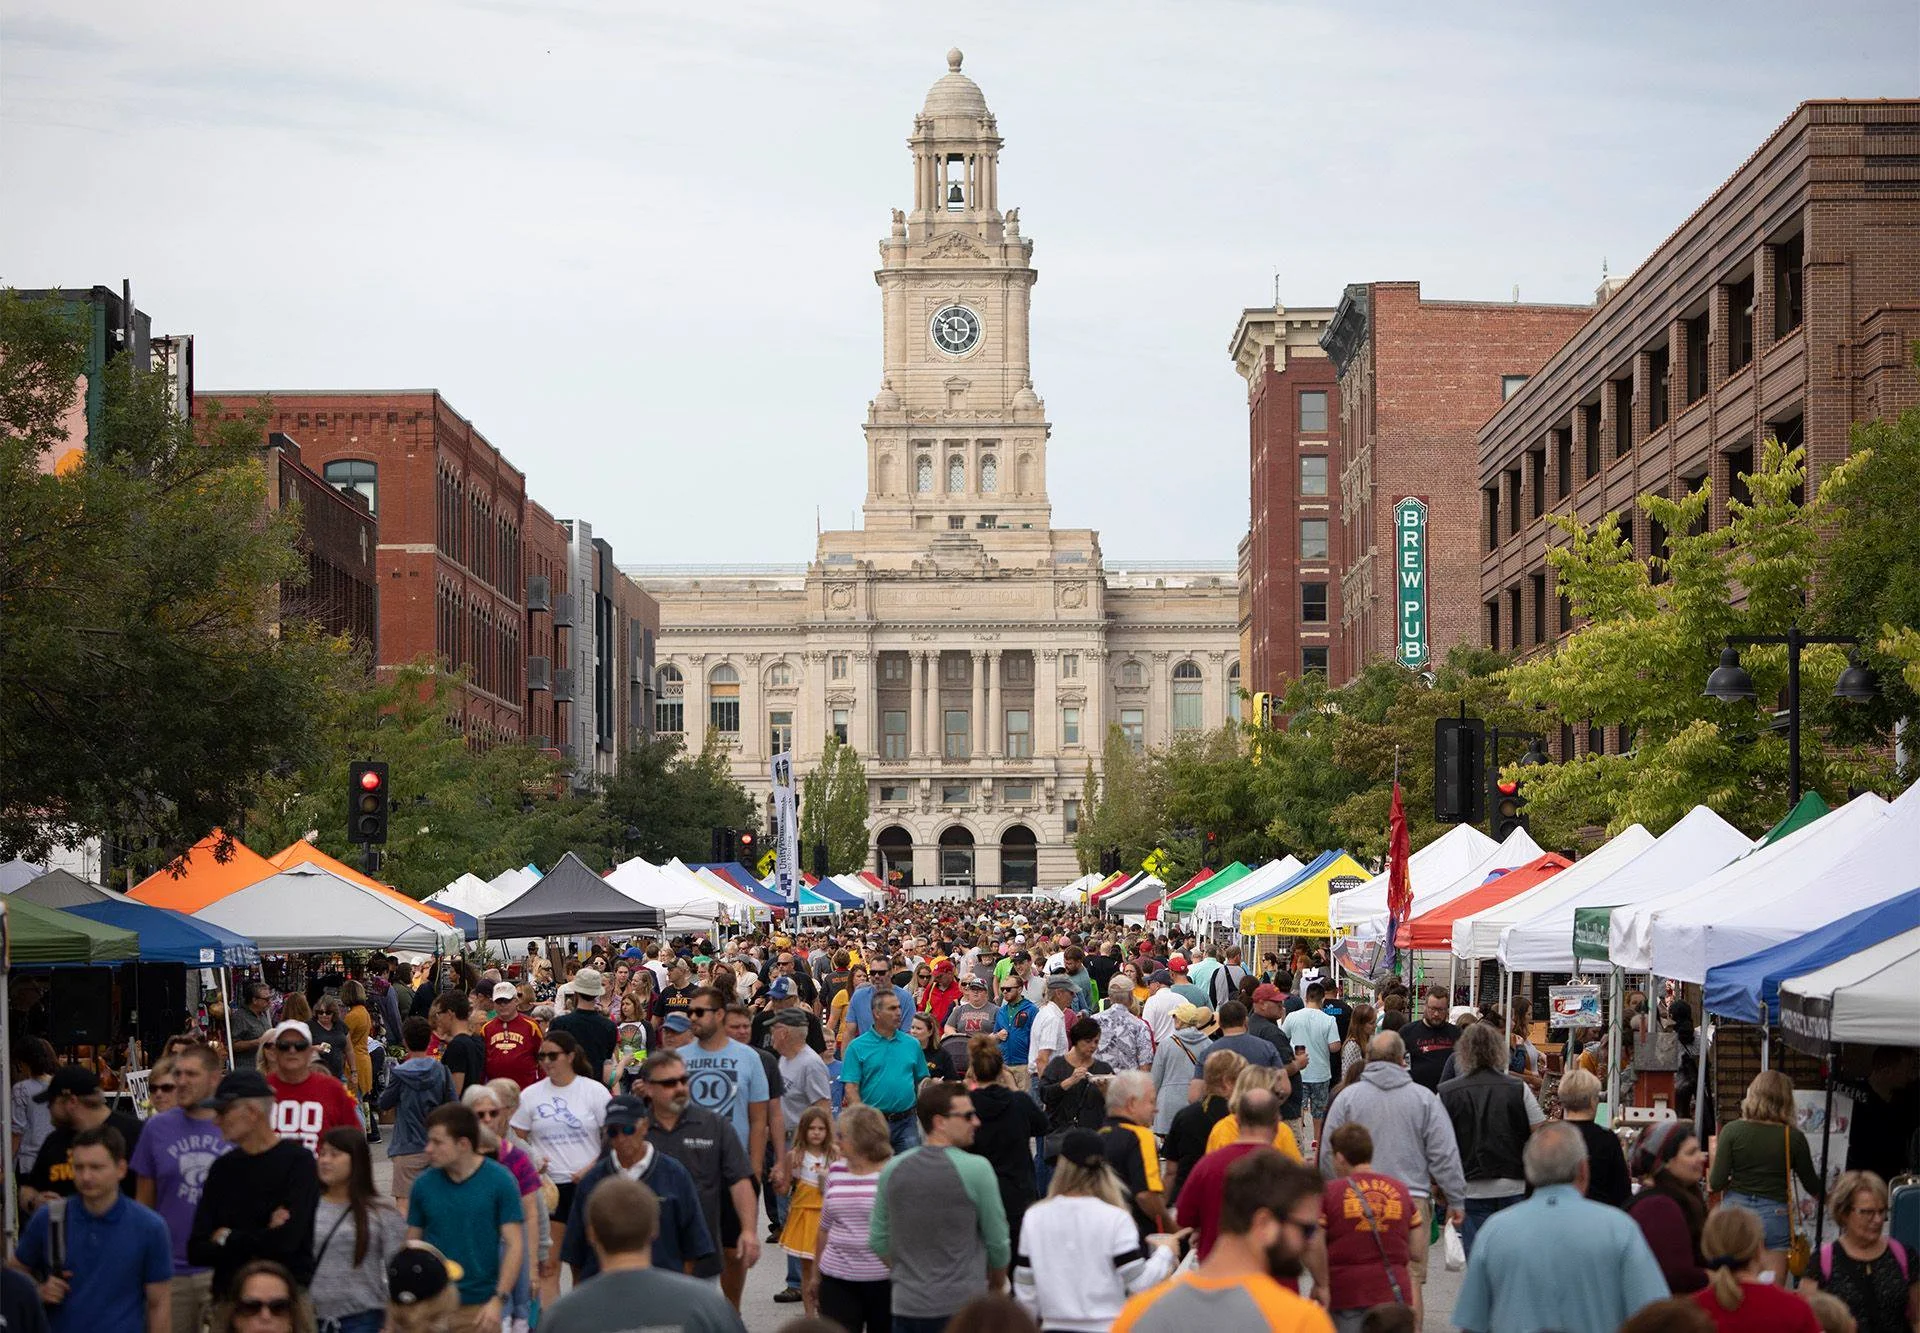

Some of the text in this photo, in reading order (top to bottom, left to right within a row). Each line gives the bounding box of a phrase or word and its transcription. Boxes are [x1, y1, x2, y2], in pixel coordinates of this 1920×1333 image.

[1401, 510, 1422, 658] BREW PUB
[1279, 917, 1326, 927] Meals From
[686, 1058, 739, 1069] HURLEY
